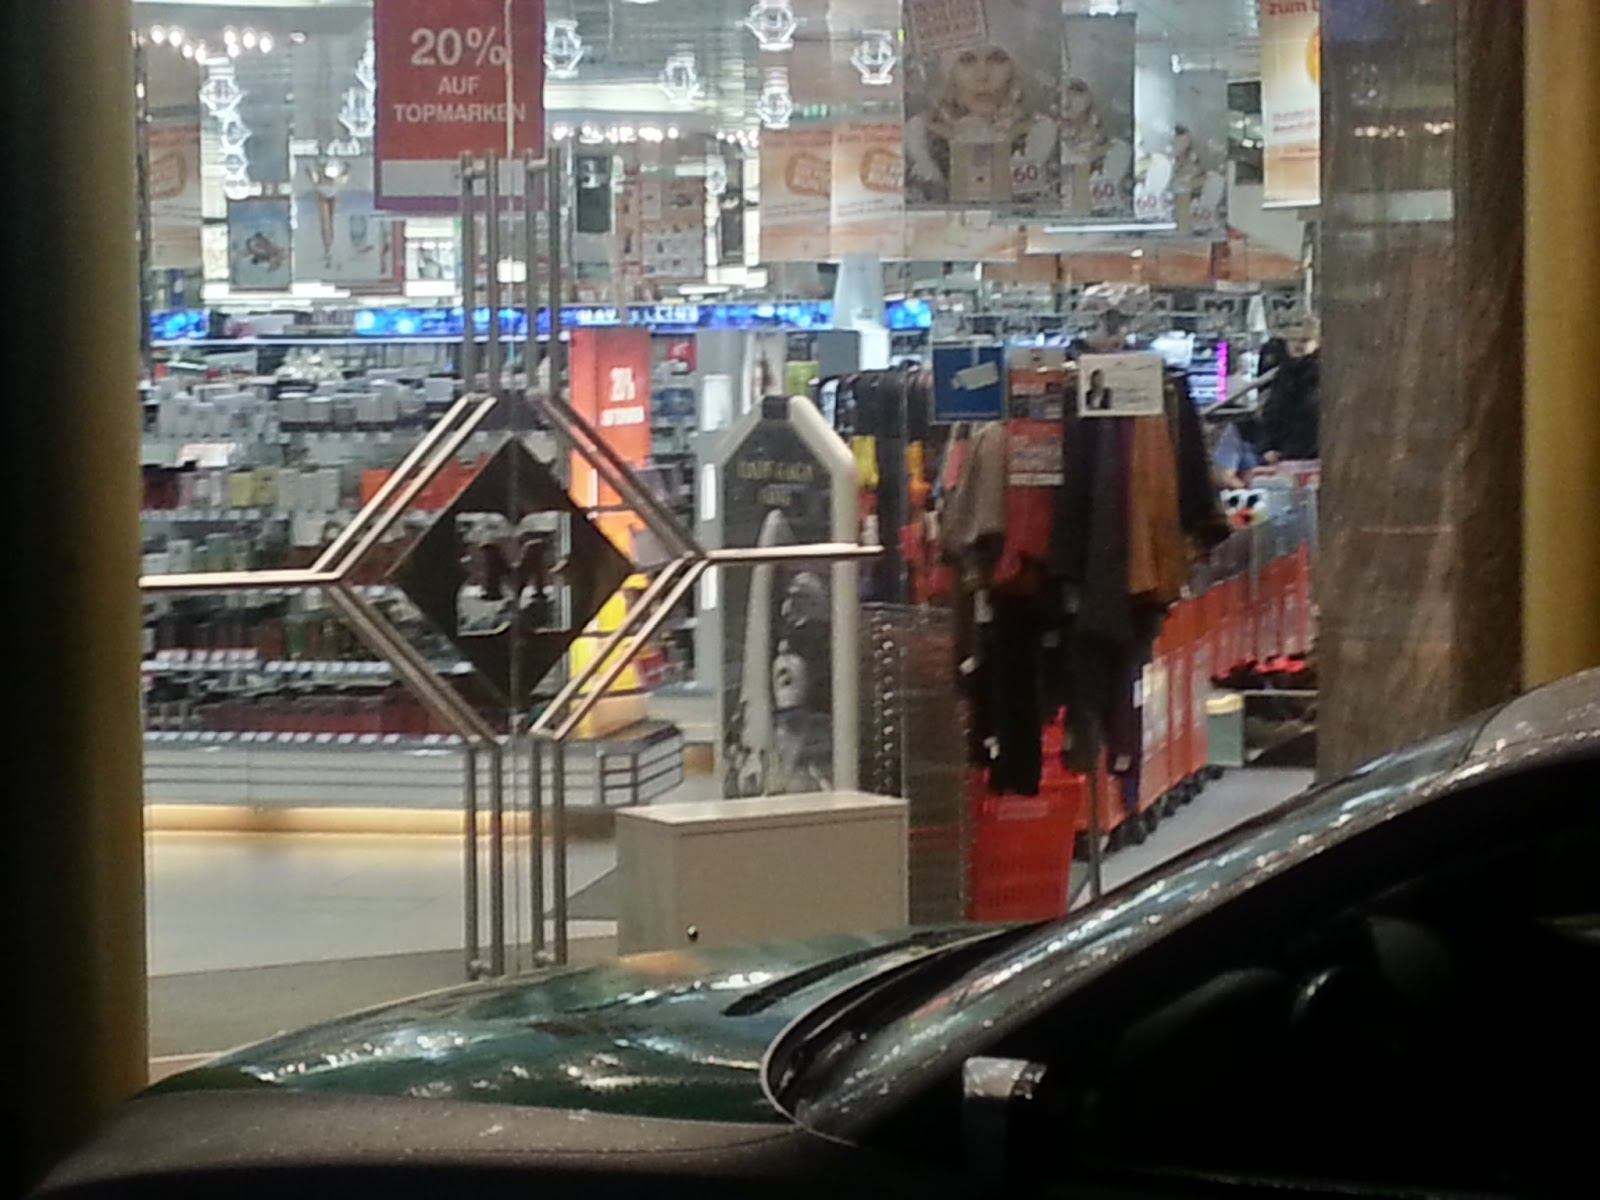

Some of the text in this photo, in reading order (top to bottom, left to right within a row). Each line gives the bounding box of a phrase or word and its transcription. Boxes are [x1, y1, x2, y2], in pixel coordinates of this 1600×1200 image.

[410, 27, 508, 67] 20%
[437, 75, 480, 95] AUF
[394, 103, 526, 122] TOPMARKEN
